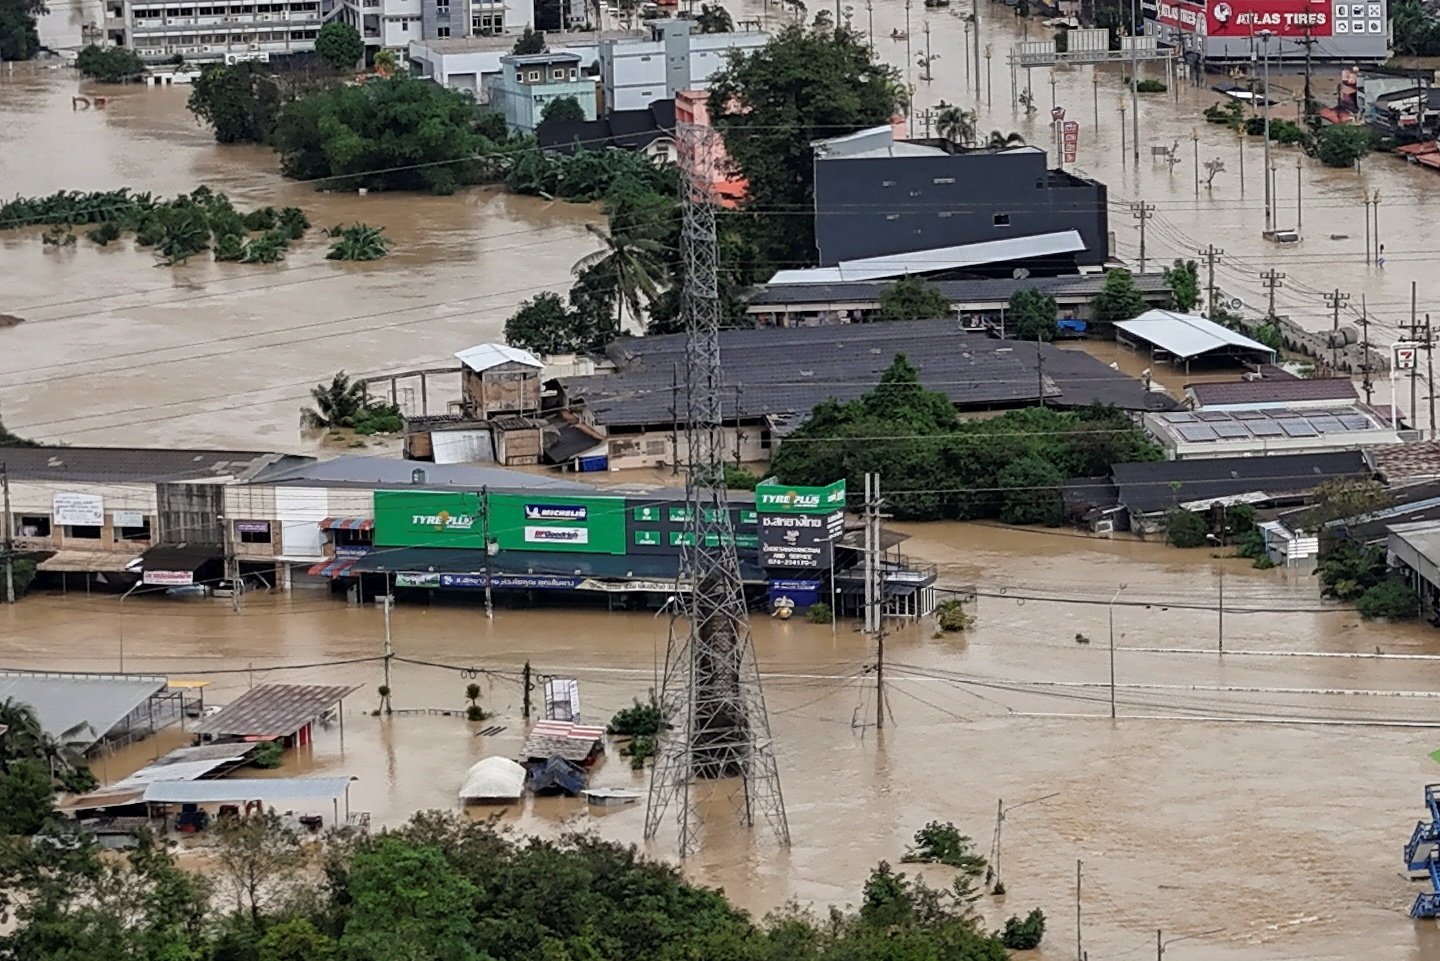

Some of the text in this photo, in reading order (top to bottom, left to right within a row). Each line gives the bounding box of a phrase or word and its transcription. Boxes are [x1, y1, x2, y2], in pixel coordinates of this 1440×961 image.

[1236, 12, 1327, 25] ATLAS TIRES
[412, 515, 441, 525] TYRE
